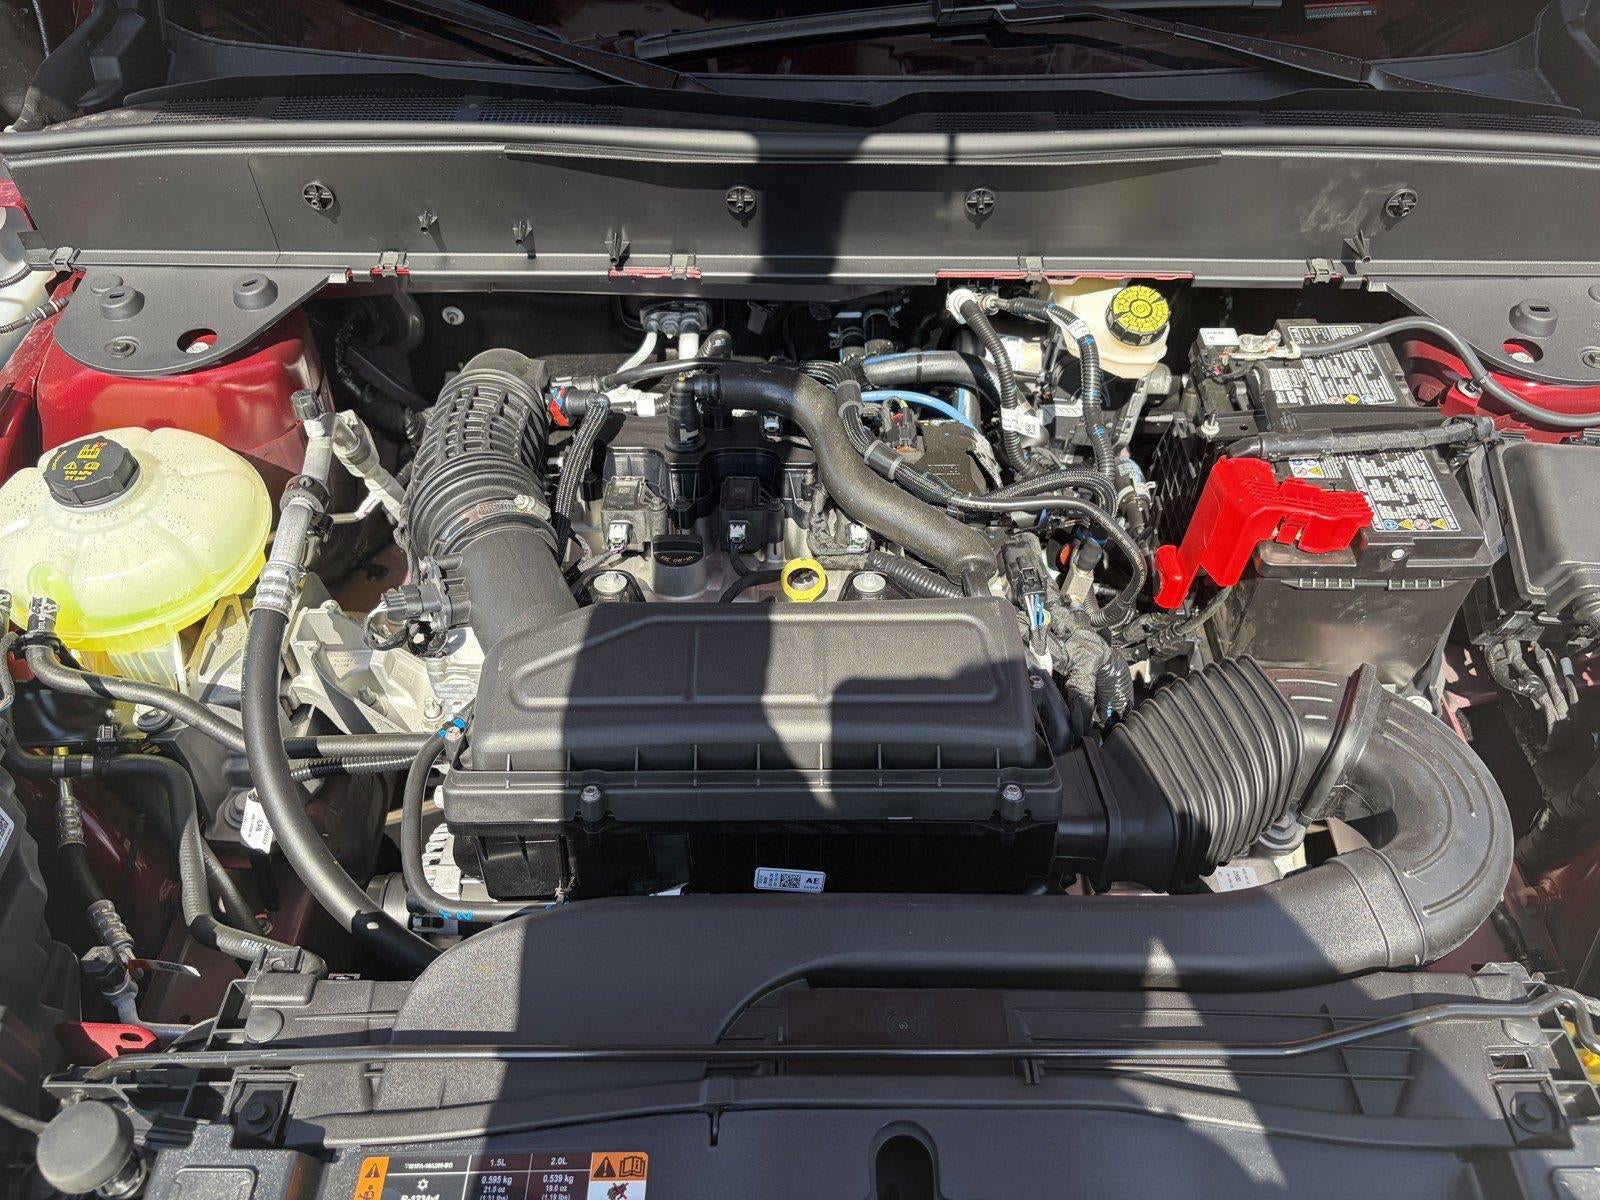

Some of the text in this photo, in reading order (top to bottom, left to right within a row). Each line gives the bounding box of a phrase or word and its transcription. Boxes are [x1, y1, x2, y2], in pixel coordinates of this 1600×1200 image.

[490, 1158, 507, 1167] 1.5L
[550, 1157, 568, 1166] 2.0L
[481, 1175, 513, 1185] 0.595 kg
[543, 1174, 574, 1184] 0.539 kg
